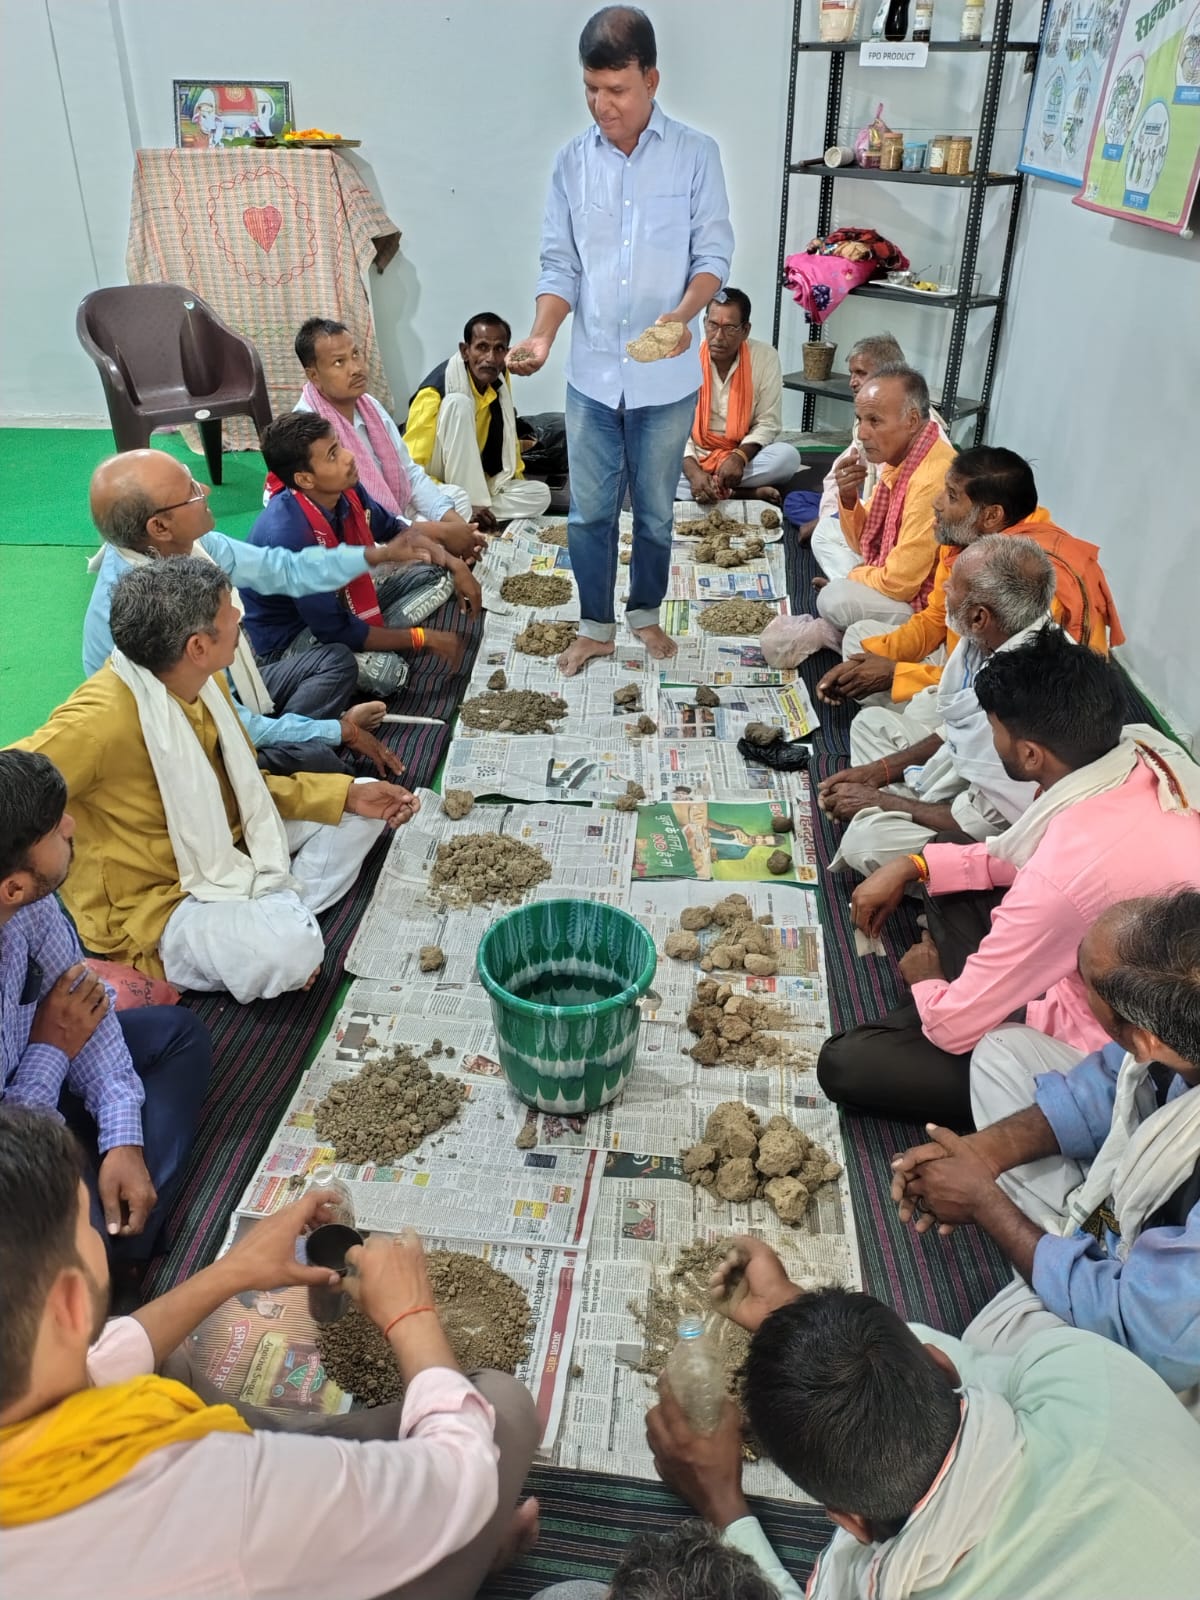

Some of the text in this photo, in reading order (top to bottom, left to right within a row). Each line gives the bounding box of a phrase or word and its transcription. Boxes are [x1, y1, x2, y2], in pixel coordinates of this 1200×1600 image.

[868, 51, 916, 61] FPO PRODUCT
[538, 1248, 553, 1270] पिटाई
[537, 1269, 549, 1278] के
[533, 1280, 546, 1296] बाद
[223, 1326, 246, 1365] KAMLA
[549, 1331, 562, 1355] अपना
